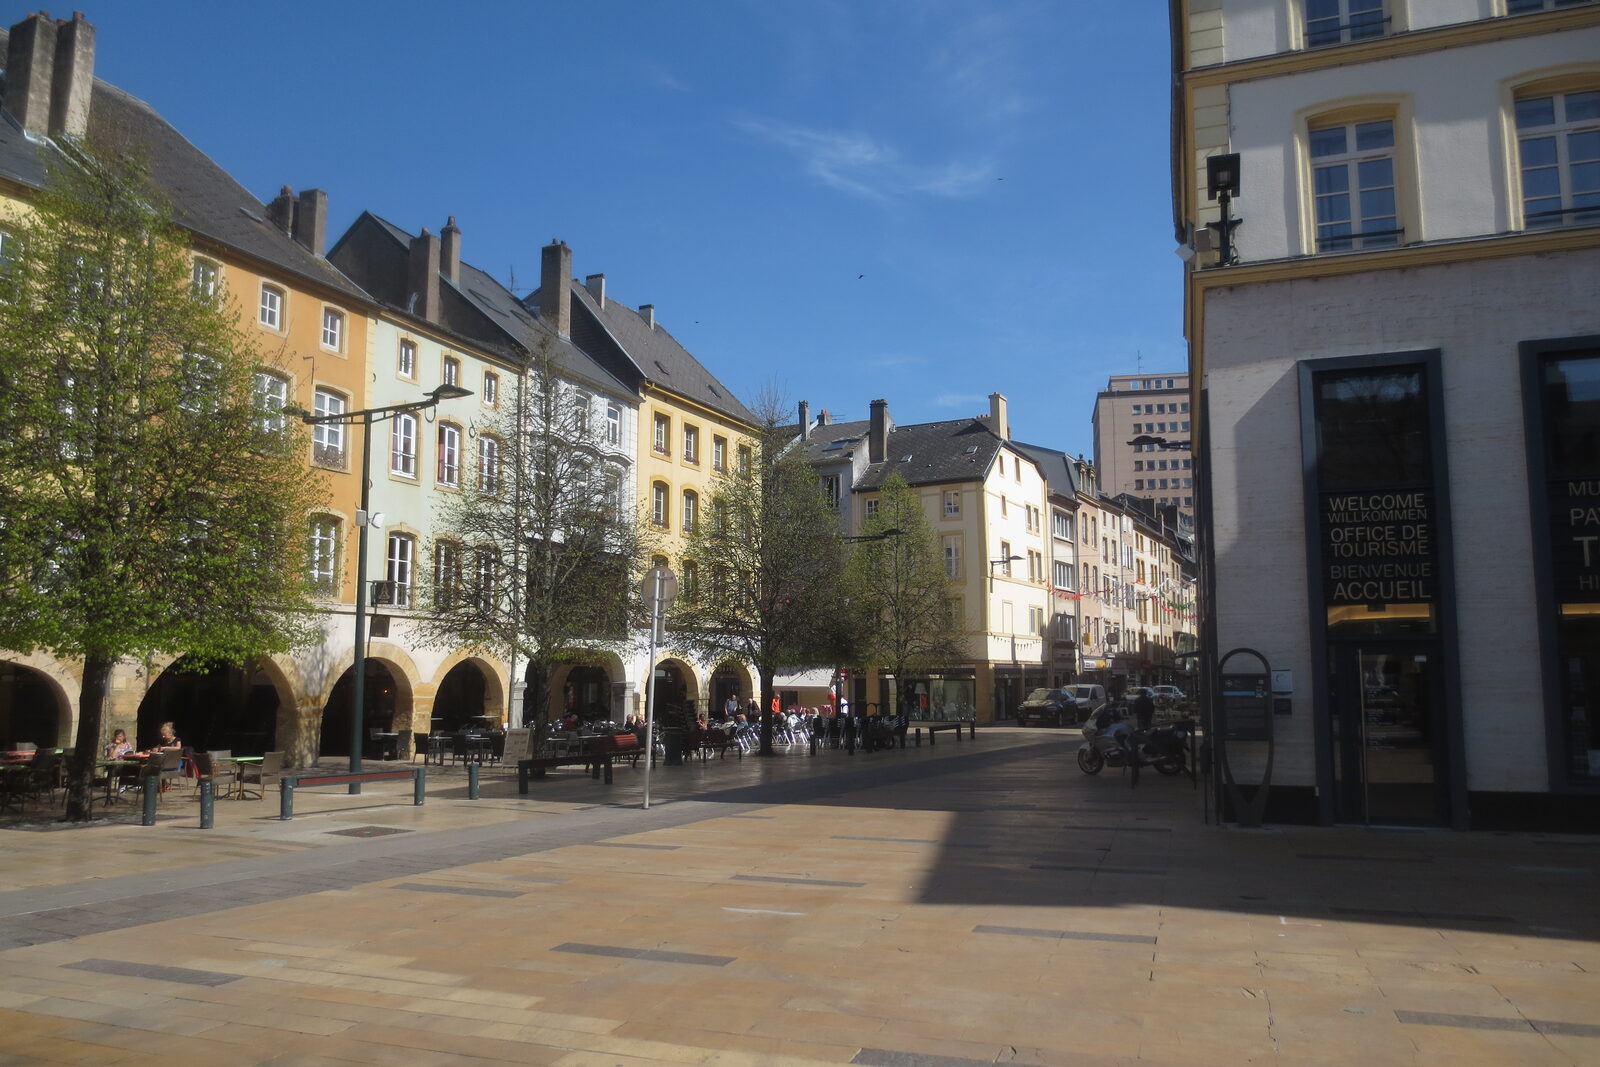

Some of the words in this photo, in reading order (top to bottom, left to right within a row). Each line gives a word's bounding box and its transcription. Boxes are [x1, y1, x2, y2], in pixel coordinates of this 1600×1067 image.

[1329, 493, 1425, 511] WELCOME
[1328, 509, 1428, 523] WILLKOMMEN
[1570, 507, 1600, 526] PA
[1330, 525, 1396, 542] OFFICE
[1402, 524, 1429, 540] DE
[1331, 540, 1430, 557] TOURISME
[1330, 562, 1432, 579] BIENVENUE
[1333, 580, 1432, 600] ACCUEIL
